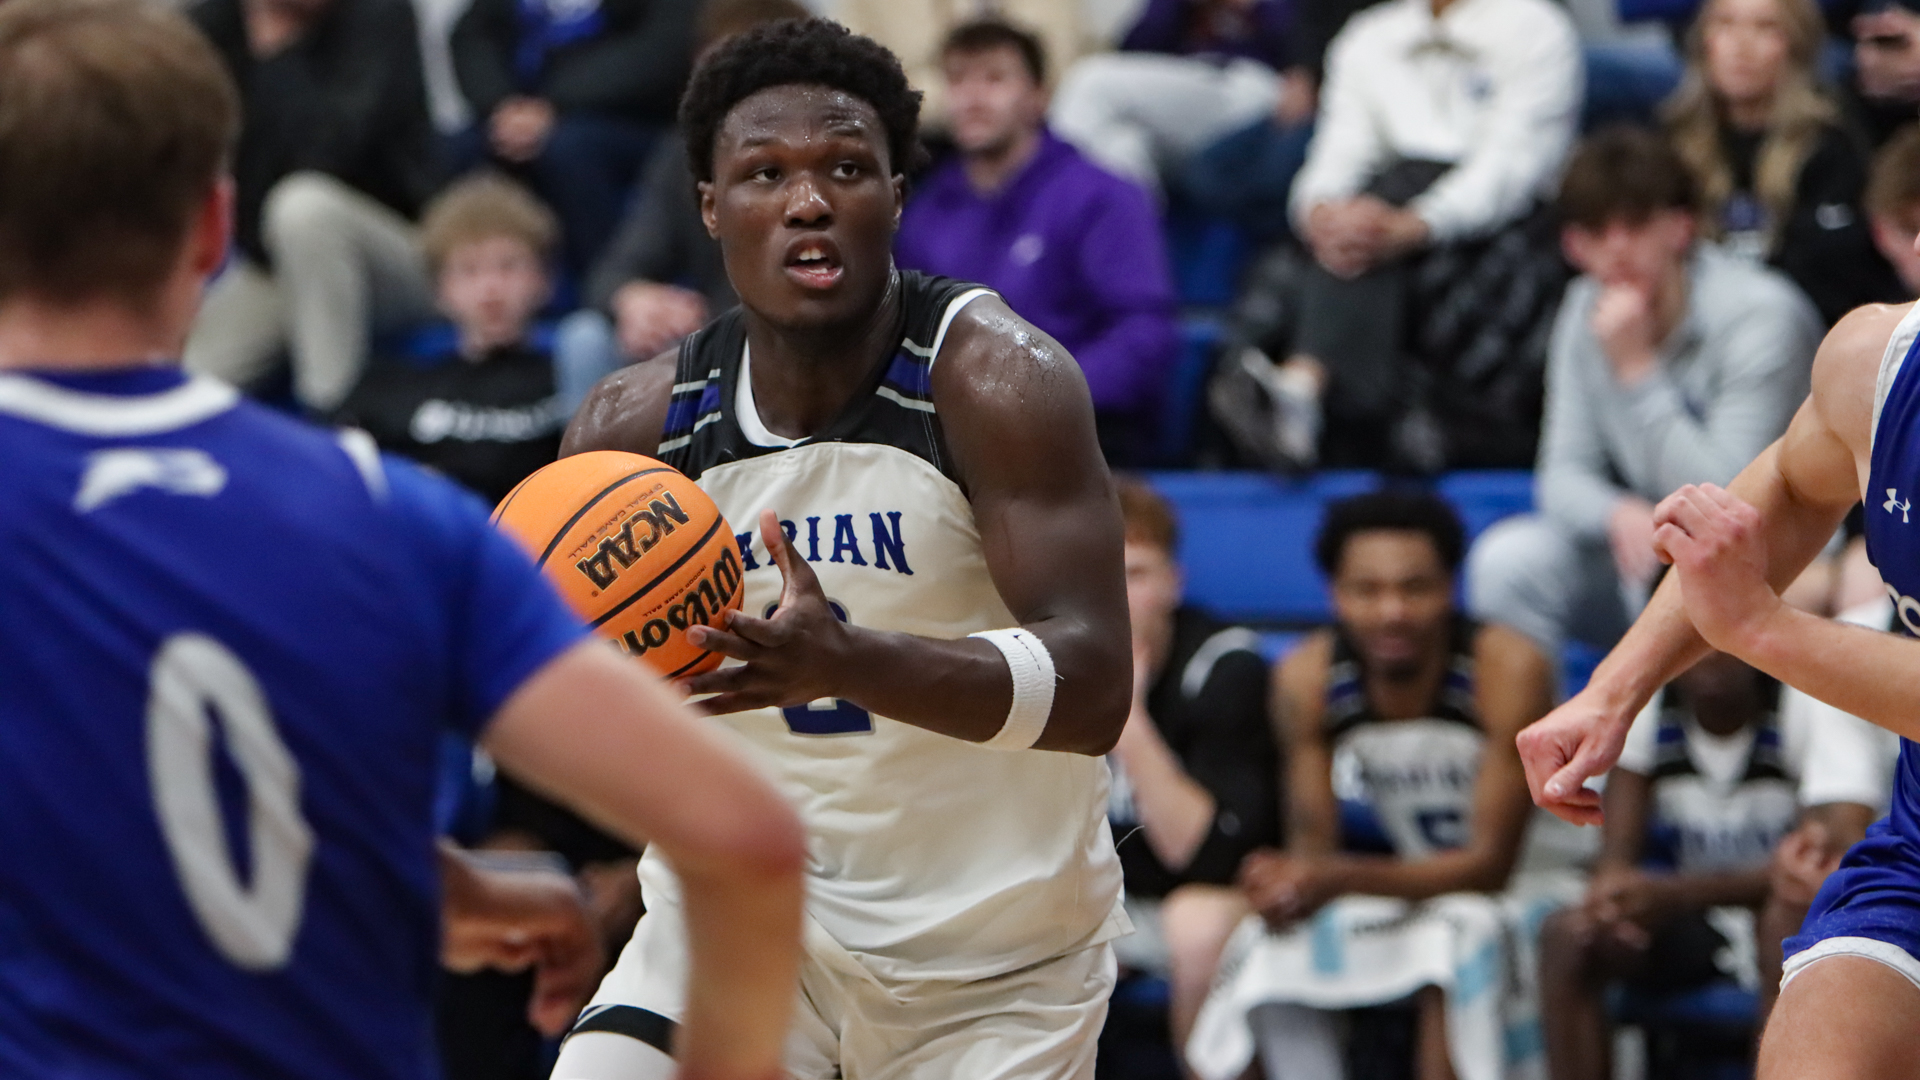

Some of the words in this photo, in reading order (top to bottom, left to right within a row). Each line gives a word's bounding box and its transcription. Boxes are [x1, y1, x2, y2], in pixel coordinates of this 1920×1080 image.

[597, 510, 626, 536] GAME
[568, 535, 597, 558] BALL
[575, 491, 690, 592] NCAA
[685, 565, 707, 588] INDOOR
[664, 588, 684, 604] GAME
[642, 604, 662, 617] BALL
[147, 632, 316, 971] 0
